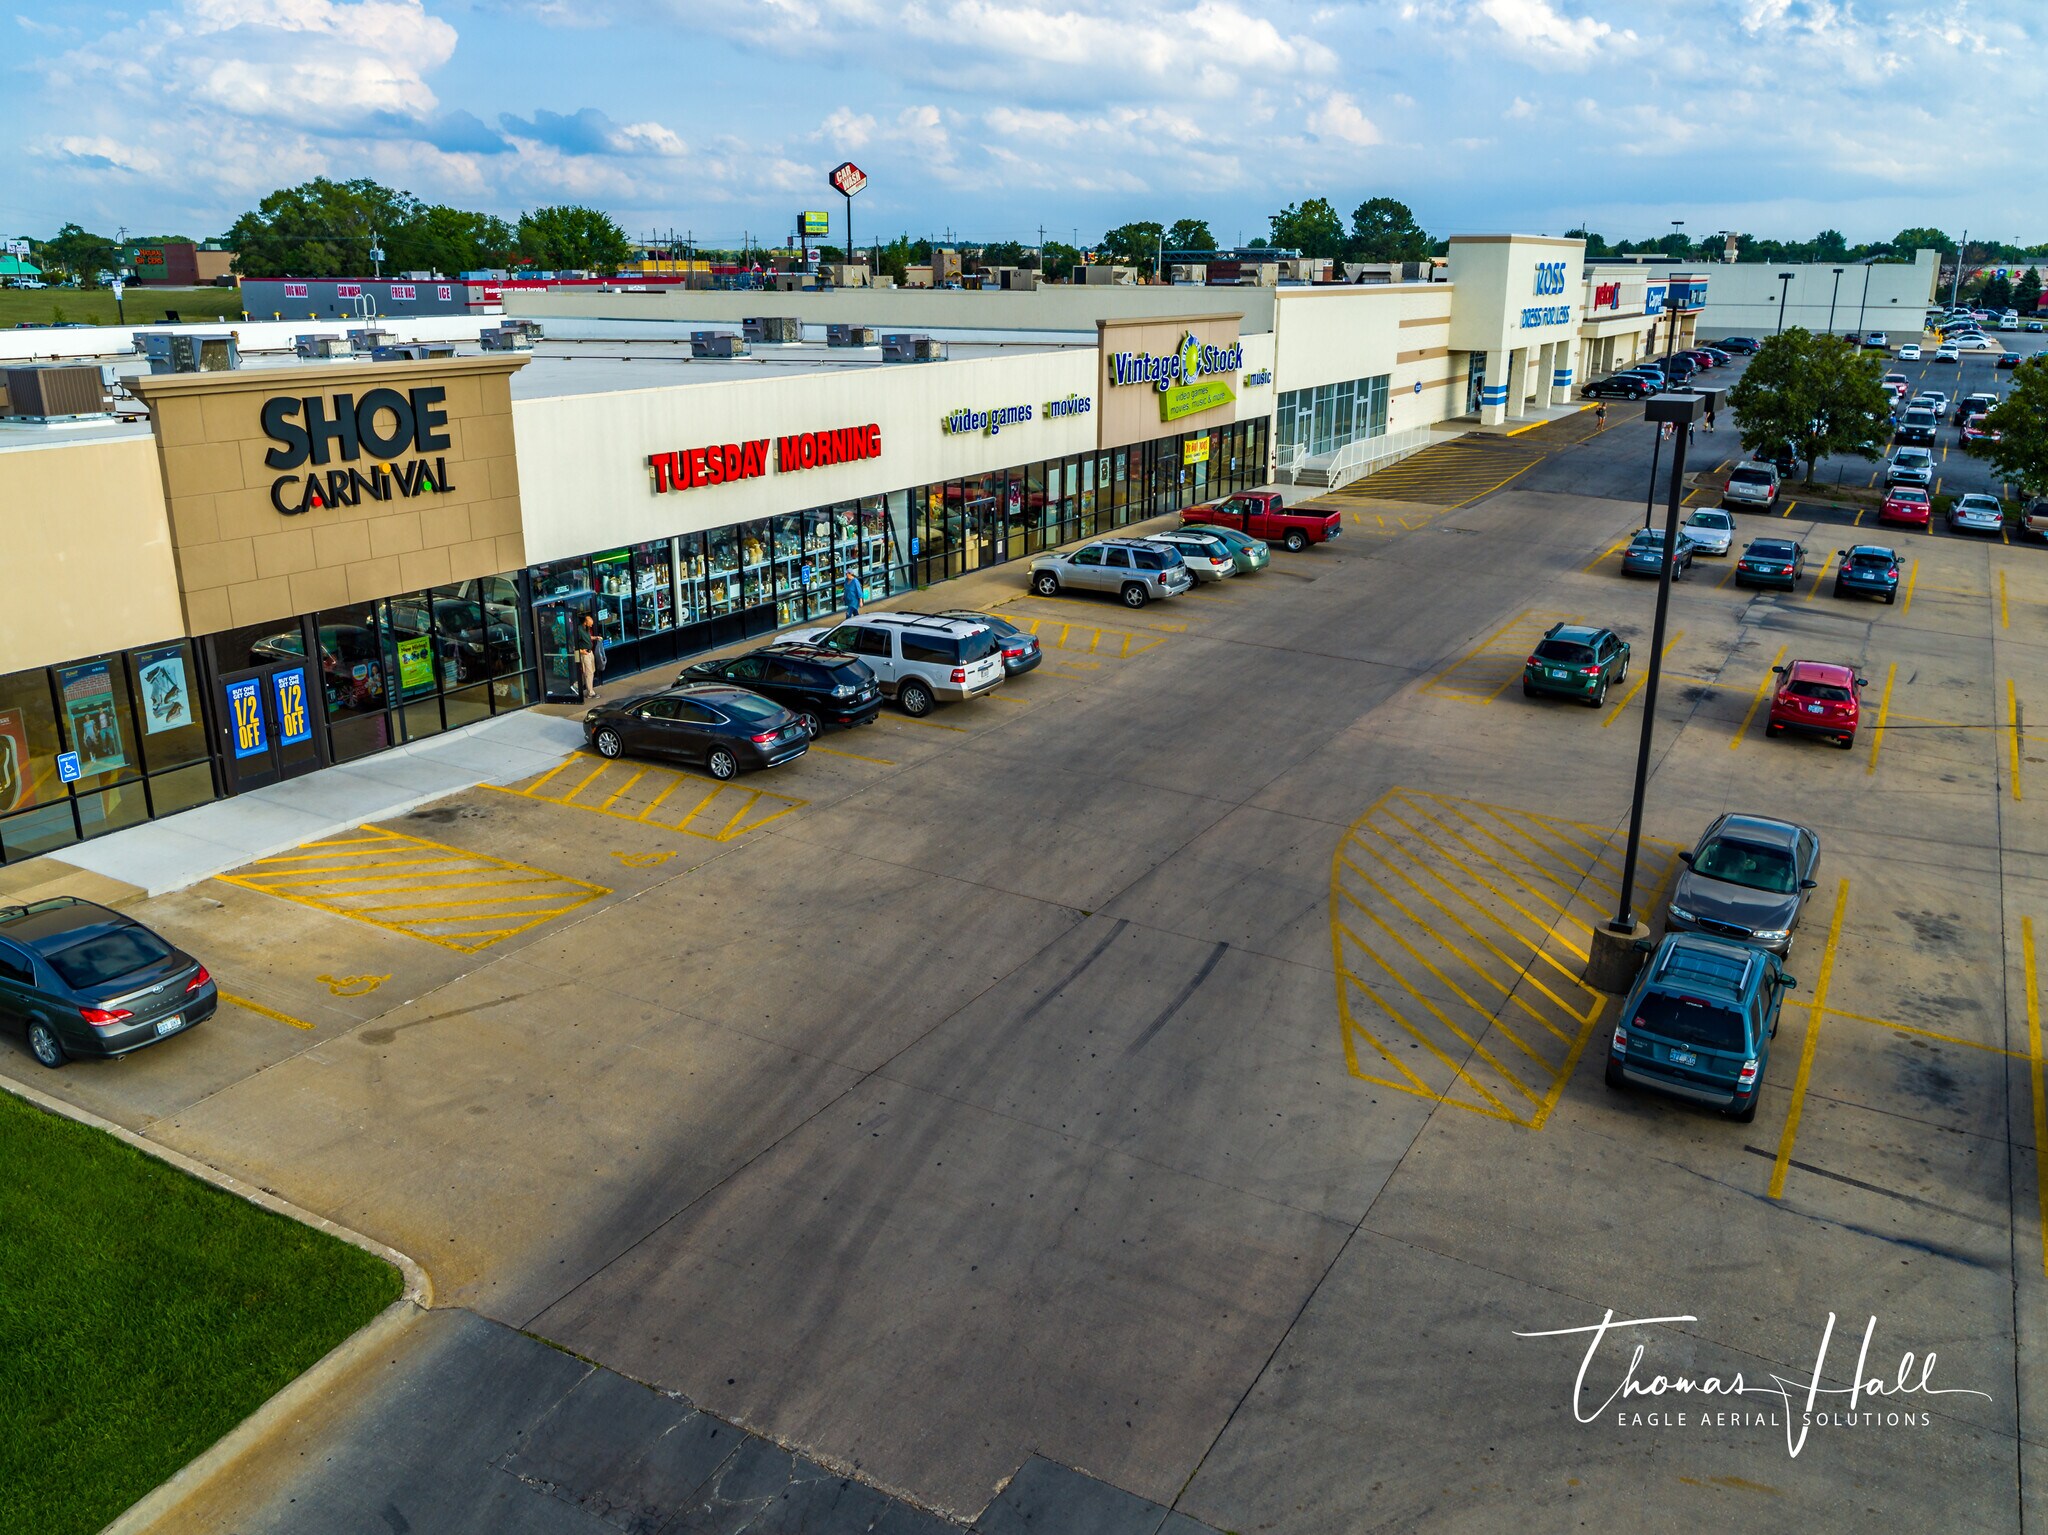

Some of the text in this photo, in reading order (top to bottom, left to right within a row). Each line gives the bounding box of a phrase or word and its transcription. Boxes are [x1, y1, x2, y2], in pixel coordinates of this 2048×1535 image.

[836, 165, 852, 183] CAR
[842, 169, 861, 190] WASH
[1535, 262, 1566, 295] ROSS
[285, 285, 307, 297] DOG WASH
[338, 286, 361, 298] CAR WASH
[391, 286, 416, 299] FREE VAC
[438, 287, 451, 299] ICE
[1521, 308, 1542, 328] DRESS
[1556, 305, 1570, 325] LESS
[1114, 351, 1180, 392] Vintage
[1202, 342, 1244, 375] Stock
[1248, 367, 1272, 386] music
[1049, 393, 1091, 418] movies
[1175, 387, 1208, 401] video games
[1192, 397, 1206, 408] music
[1213, 392, 1225, 401] more
[260, 385, 452, 470] SHOE
[948, 404, 1032, 435] video games
[648, 423, 882, 493] TUESDAY MORNING
[232, 685, 254, 695] BUY ONE
[280, 685, 303, 715] 1/2
[234, 696, 259, 727] 1/2
[284, 710, 304, 737] OFF
[239, 722, 259, 749] OFF
